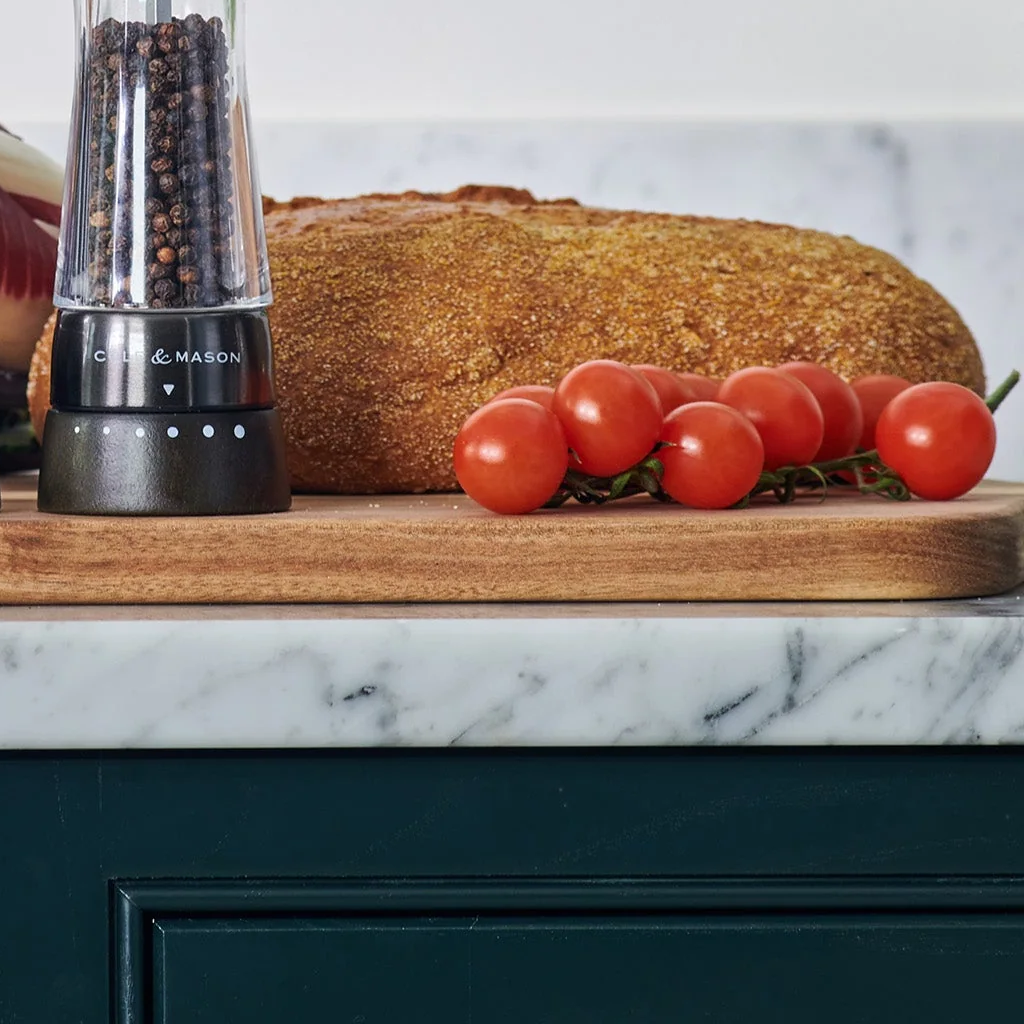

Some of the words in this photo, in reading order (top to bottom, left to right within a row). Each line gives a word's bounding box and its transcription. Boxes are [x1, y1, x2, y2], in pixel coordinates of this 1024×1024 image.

[93, 350, 145, 363] CL
[151, 348, 173, 365] &
[176, 351, 241, 363] MASON
